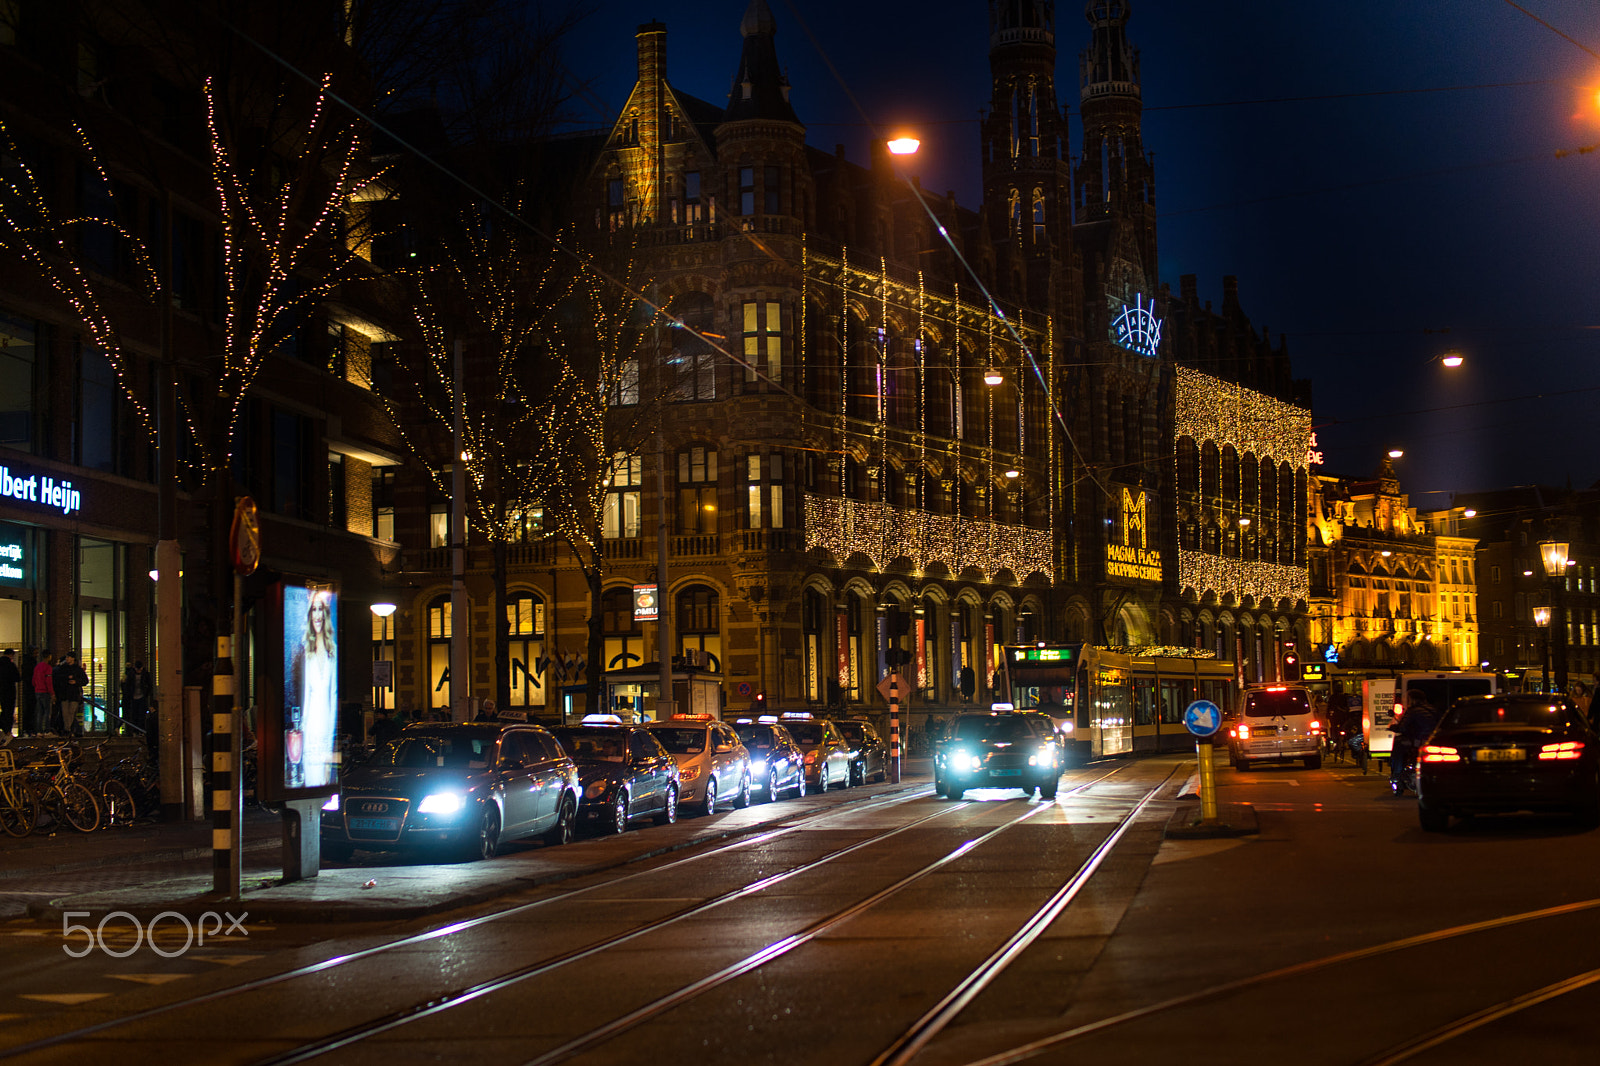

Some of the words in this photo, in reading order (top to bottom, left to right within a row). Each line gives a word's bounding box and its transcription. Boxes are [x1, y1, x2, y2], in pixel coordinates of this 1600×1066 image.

[41, 476, 81, 515] Heijn
[1107, 544, 1138, 564] MAGNA
[1138, 548, 1162, 567] PLAZA
[1107, 561, 1140, 579] SHOPPING
[1140, 565, 1163, 582] CENTRE
[1306, 665, 1312, 673] 5
